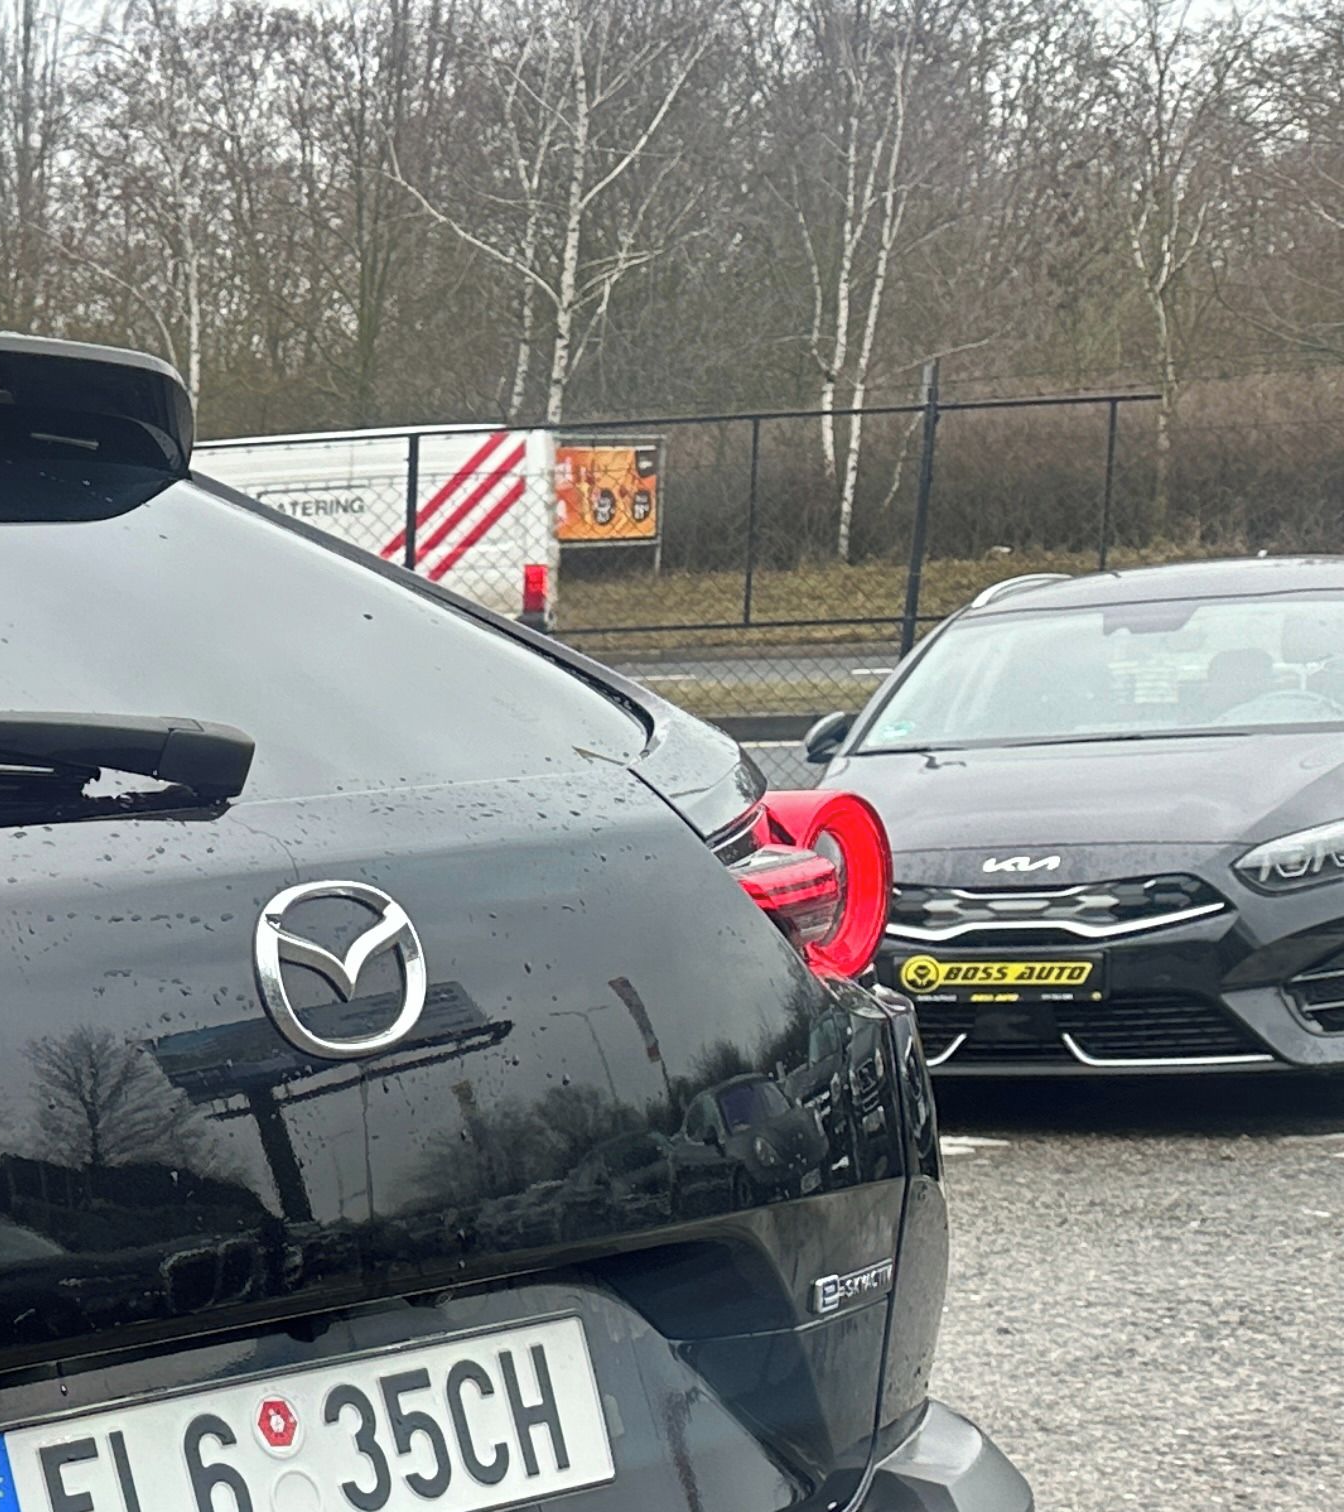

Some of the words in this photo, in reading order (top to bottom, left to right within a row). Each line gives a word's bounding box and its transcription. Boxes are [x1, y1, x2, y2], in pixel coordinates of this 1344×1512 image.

[276, 496, 366, 517] ATERING
[944, 966, 1010, 982] BOSS
[1014, 965, 1088, 982] AUTO
[323, 1342, 571, 1512] 35CH
